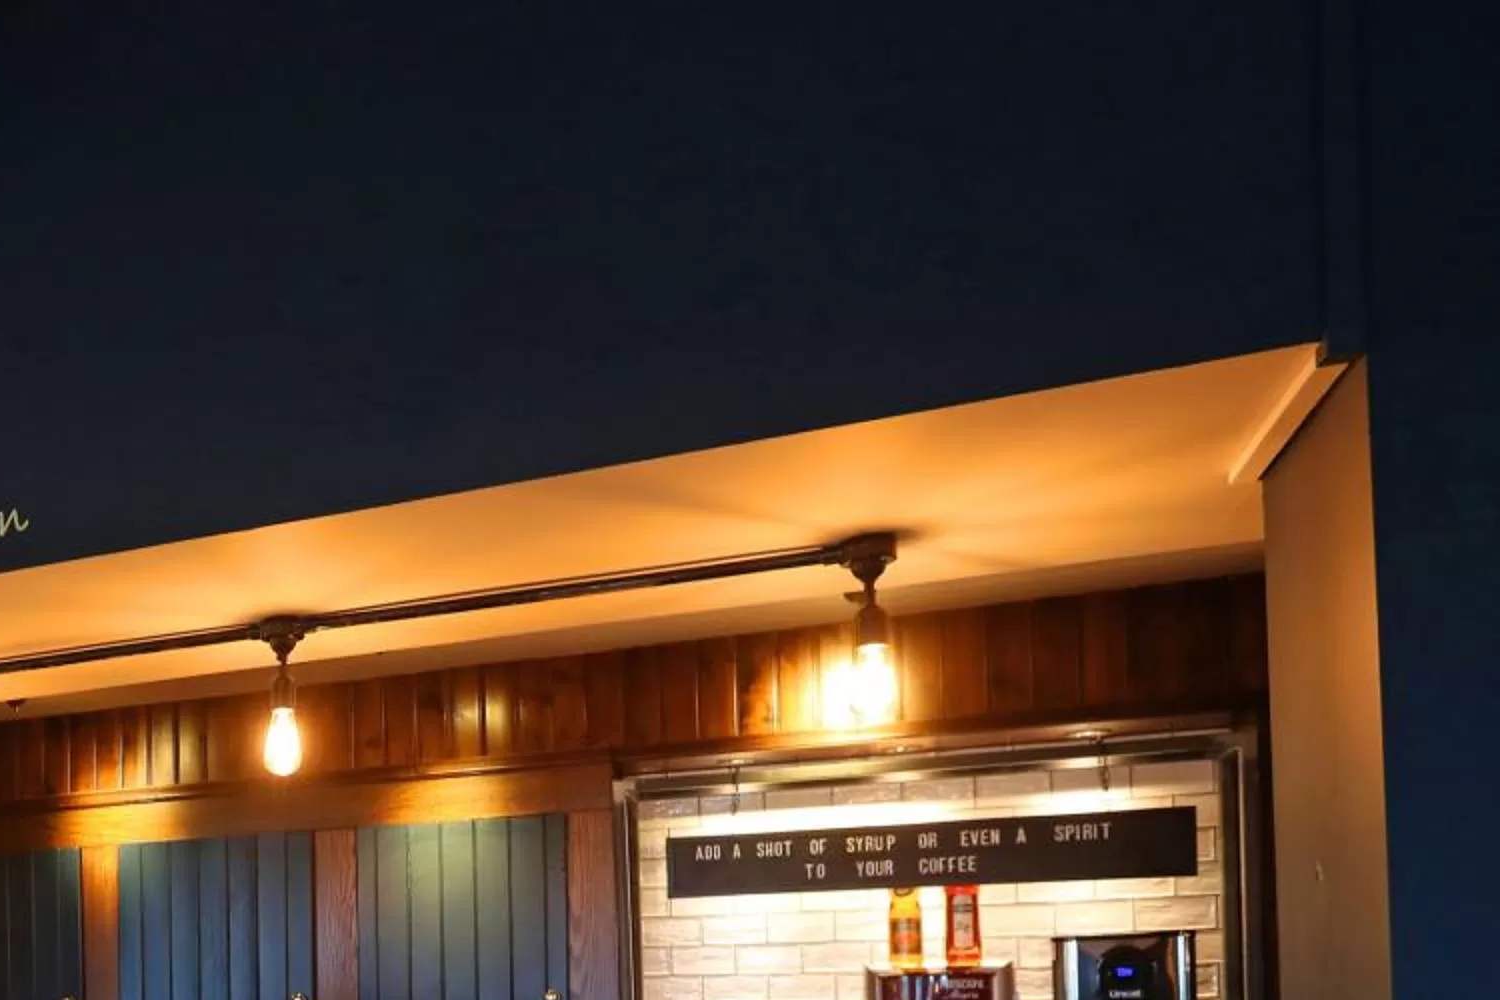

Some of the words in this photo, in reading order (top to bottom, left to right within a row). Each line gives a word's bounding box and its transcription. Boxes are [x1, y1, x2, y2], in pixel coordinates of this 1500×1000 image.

[695, 844, 721, 862] ADD
[733, 843, 741, 859] A
[756, 840, 793, 858] SHOT
[809, 838, 827, 856] OF
[846, 834, 896, 853] SYRUP
[917, 832, 938, 849] OR
[960, 828, 1000, 847] EVEN
[1016, 826, 1027, 844] A
[1053, 822, 1112, 842] SPIRIT
[805, 862, 826, 881] TO
[856, 860, 894, 878] YOUR
[918, 855, 977, 875] COFFEE
